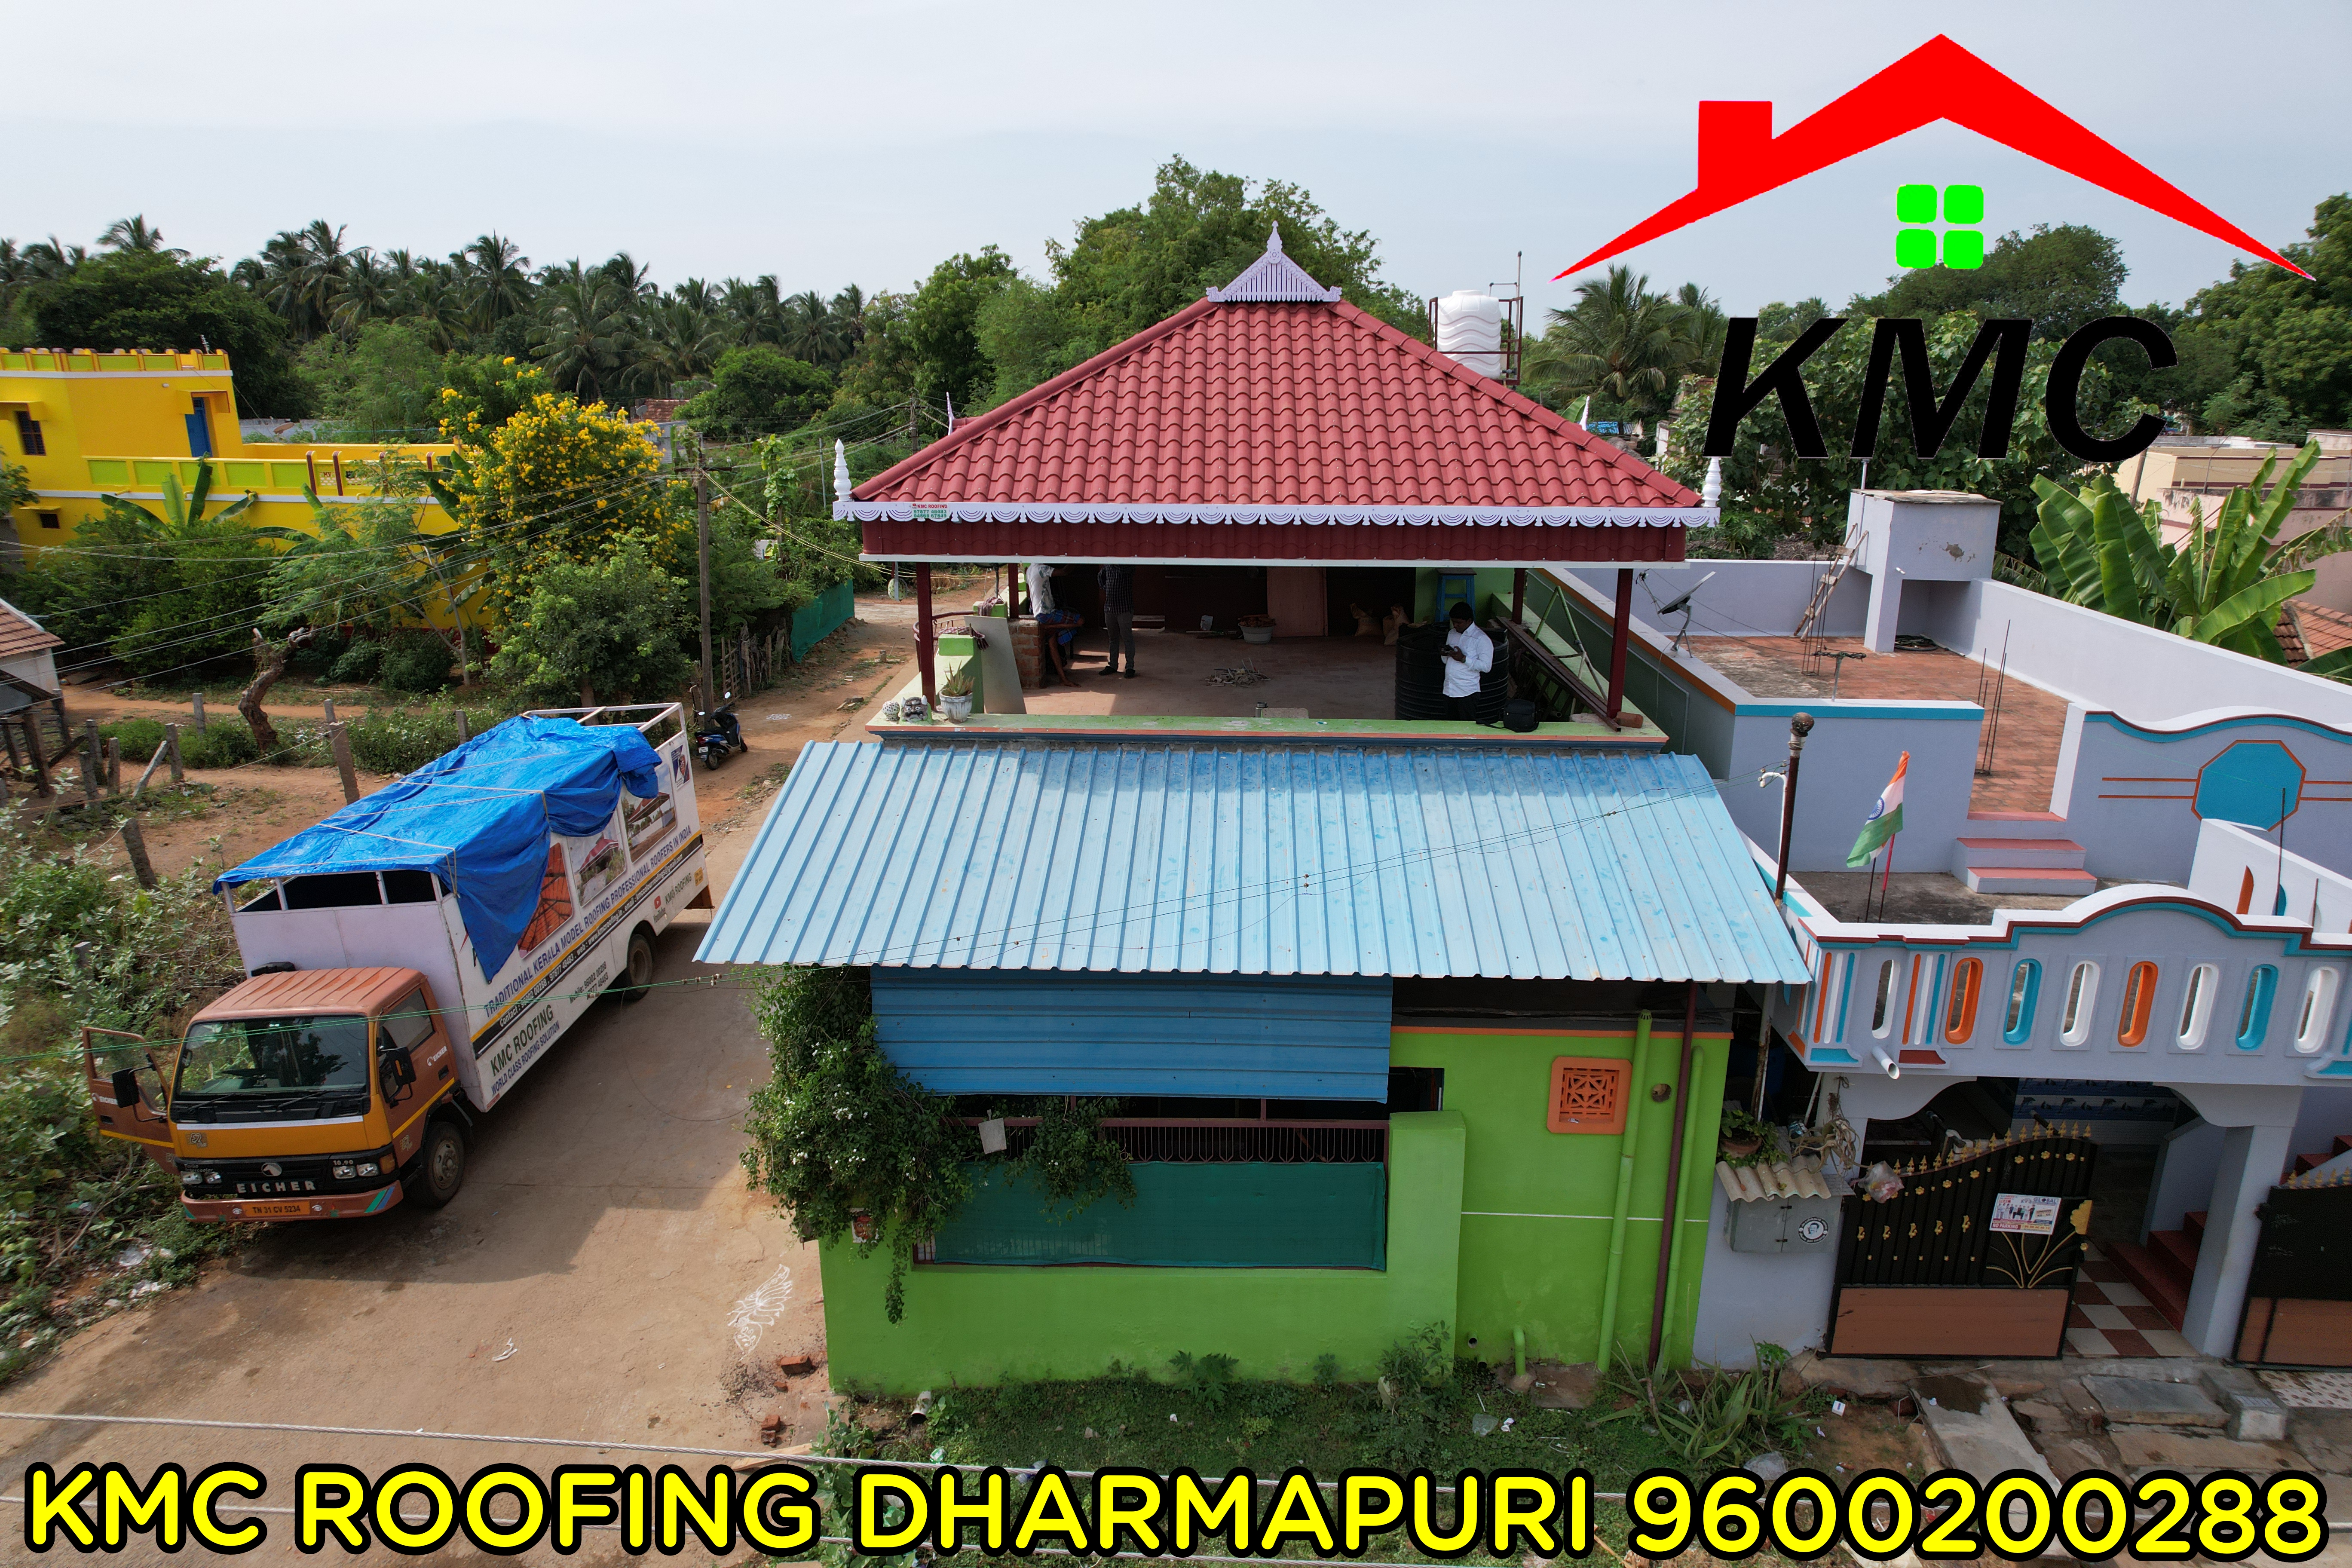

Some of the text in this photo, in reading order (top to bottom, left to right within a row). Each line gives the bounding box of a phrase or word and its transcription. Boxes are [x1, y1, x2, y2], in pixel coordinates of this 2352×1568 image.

[674, 873, 692, 894] ROOFING
[484, 825, 692, 1017] TRADITIONAL KERALA MODEL ROOFING PROFESSIONAL ROOFERS IN INDIA
[500, 1007, 518, 1027] Contact
[533, 978, 547, 995] 00288
[549, 964, 562, 981] 97877
[577, 943, 585, 956] web
[625, 897, 634, 911] email
[433, 1045, 447, 1062] EICHER
[490, 1004, 554, 1076] KMC ROOFING
[491, 1073, 508, 1095] WORLD
[508, 1059, 522, 1079] CLASS
[521, 1040, 540, 1066] ROOFING
[539, 1020, 560, 1047] SOLUTION
[236, 1180, 316, 1193] EICHER
